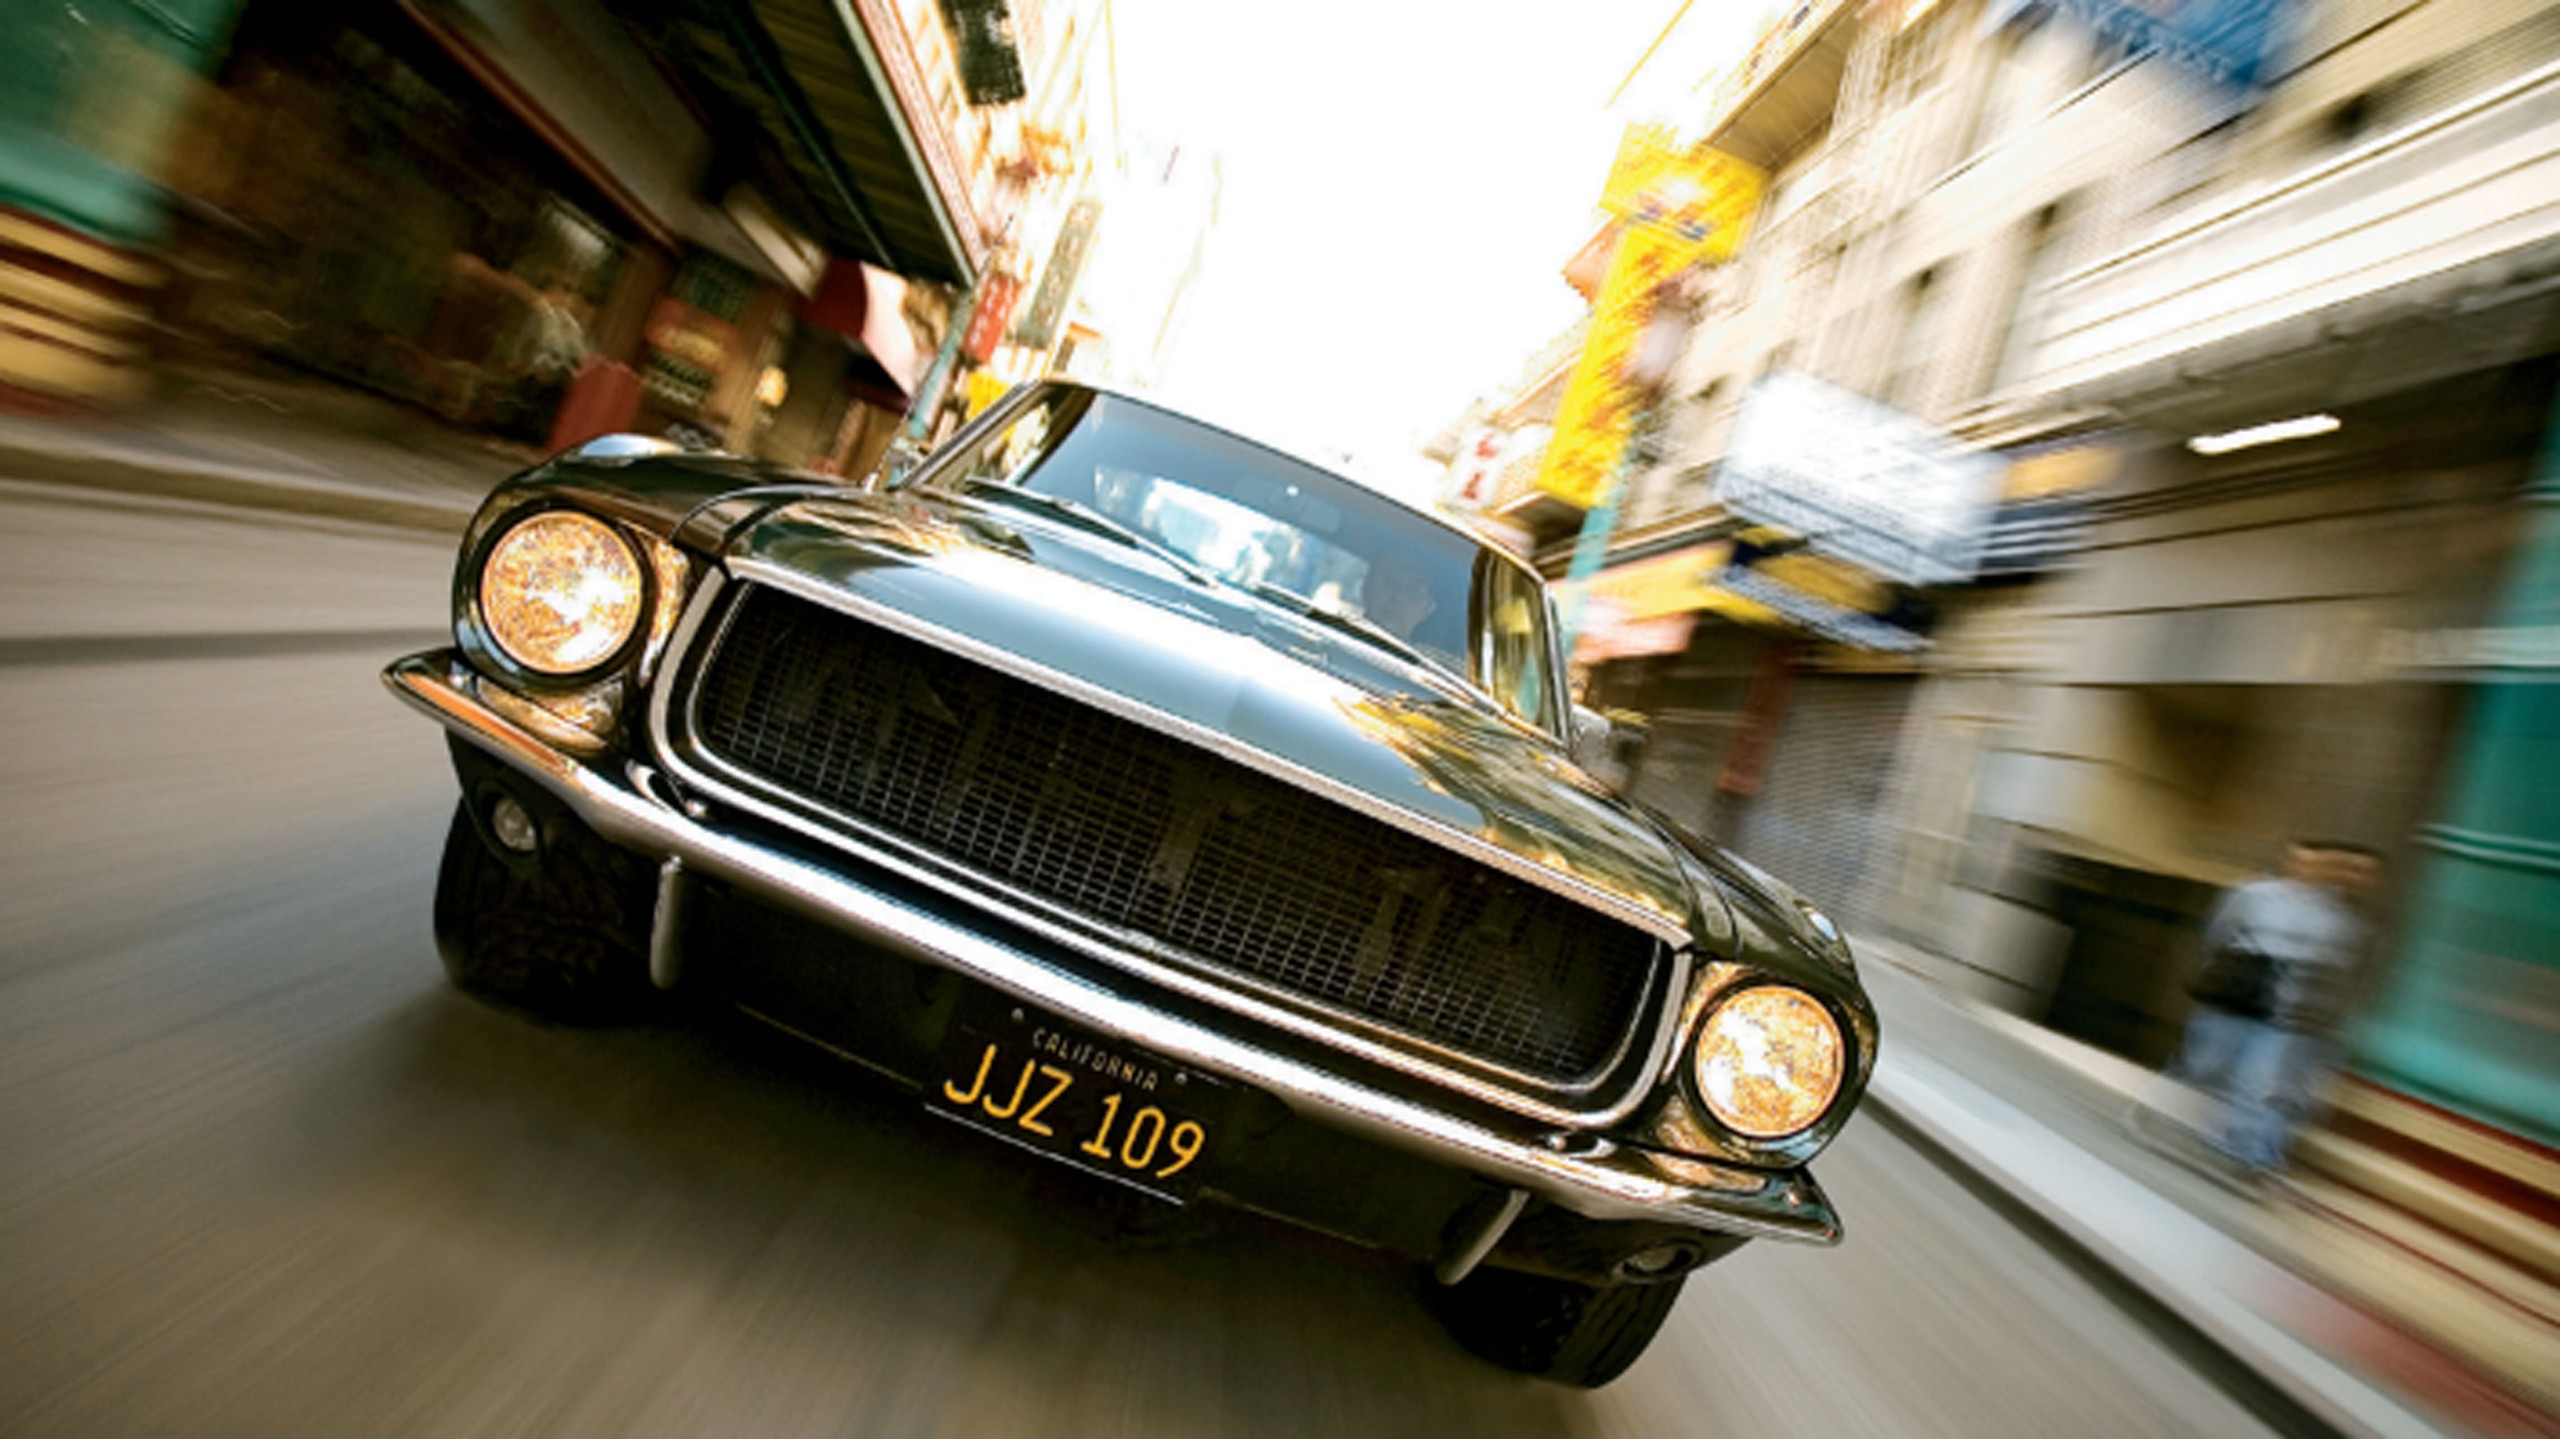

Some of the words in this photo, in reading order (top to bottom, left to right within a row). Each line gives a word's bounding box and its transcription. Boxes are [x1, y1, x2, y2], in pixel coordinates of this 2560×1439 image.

[1032, 1027, 1159, 1091] CALIFORNIA
[943, 1043, 1073, 1136] JJZ
[1080, 1093, 1205, 1178] 109
